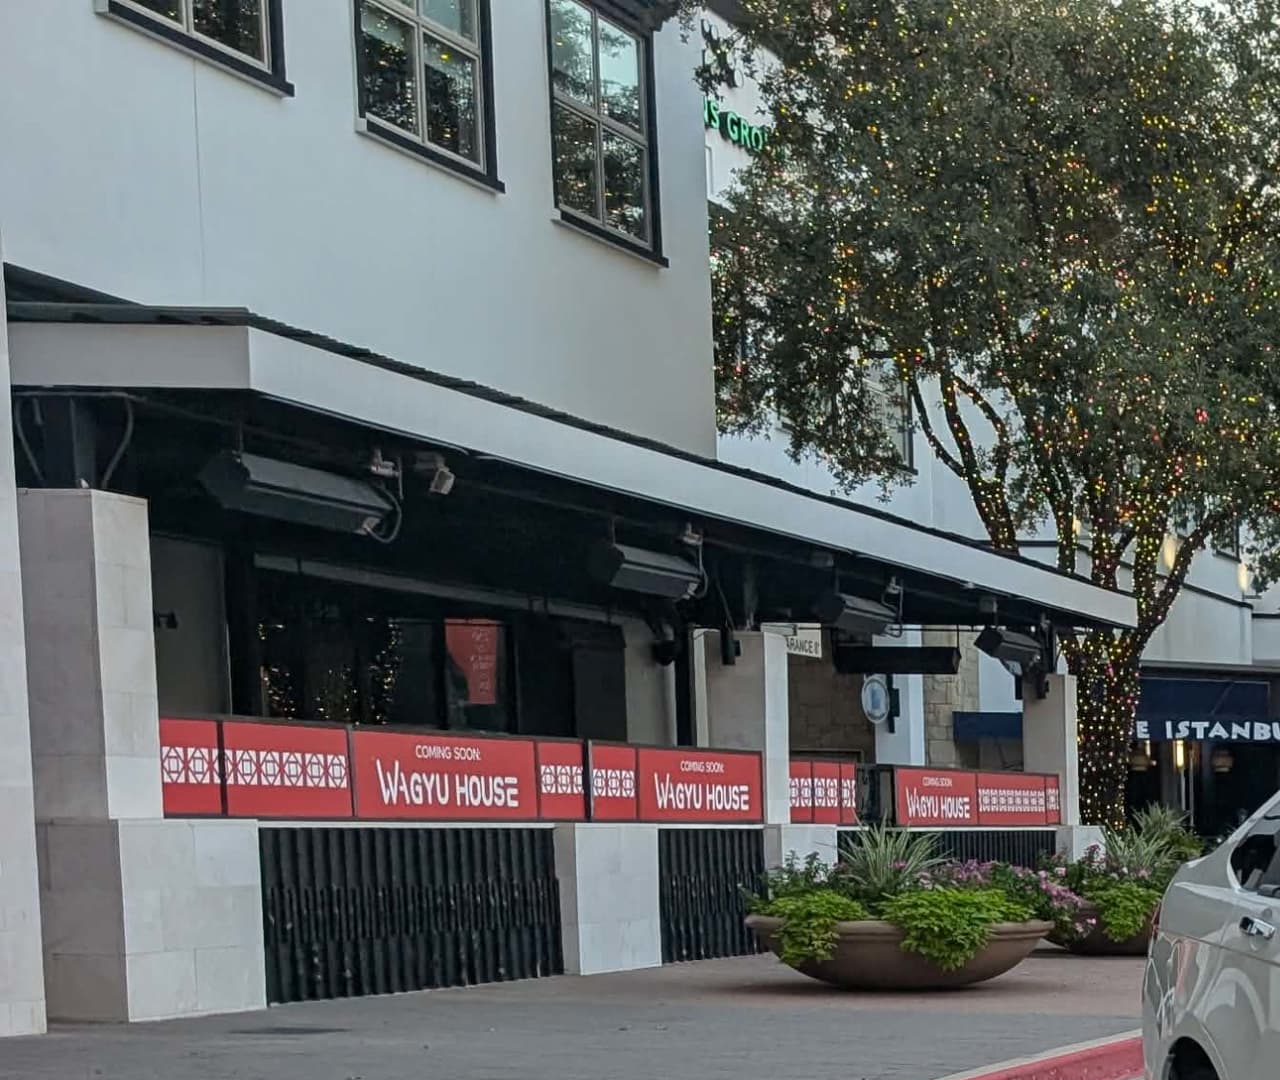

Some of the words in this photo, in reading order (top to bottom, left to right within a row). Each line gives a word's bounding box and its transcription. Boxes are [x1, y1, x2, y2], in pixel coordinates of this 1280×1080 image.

[415, 744, 452, 760] COMING
[376, 758, 450, 805] WAGYU
[455, 774, 519, 807] HOUSE
[654, 772, 702, 809] WAGYU
[706, 783, 750, 811] HOUSE
[905, 786, 938, 818] WAGYU
[940, 796, 971, 819] HOUSE
